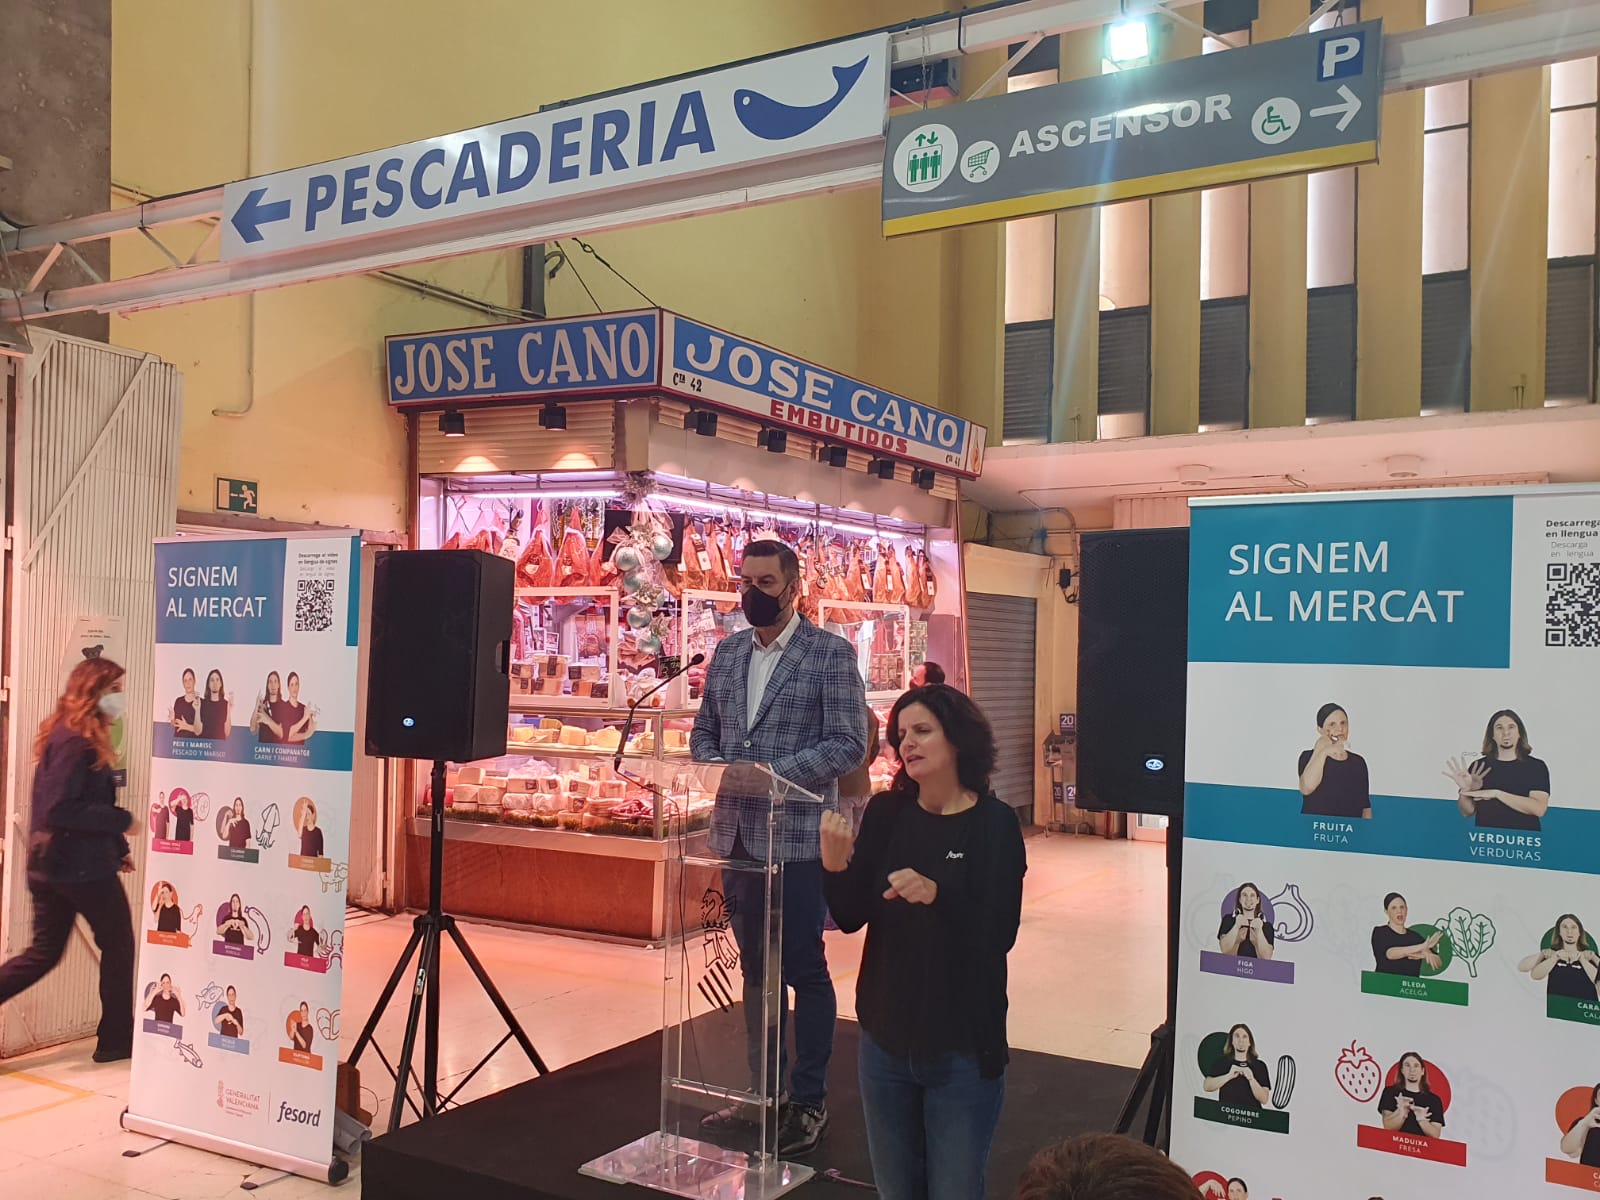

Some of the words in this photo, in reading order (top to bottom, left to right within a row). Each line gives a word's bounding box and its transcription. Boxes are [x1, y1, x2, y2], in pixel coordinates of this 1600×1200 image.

[1322, 37, 1362, 79] P
[1008, 93, 1233, 158] ASCENSOR
[304, 90, 716, 232] PESCADERIA
[394, 336, 497, 395] JOSE
[517, 322, 650, 385] CANO
[686, 335, 834, 410] JOSE
[850, 389, 958, 447] CANO
[690, 377, 702, 392] 42
[770, 399, 908, 454] EMBUTIDOS
[1560, 530, 1599, 539] llengua
[1228, 541, 1389, 575] SIGNEM
[167, 566, 238, 588] SIGNEM
[165, 597, 187, 617] AL
[193, 596, 267, 618] MERCAT
[1224, 591, 1273, 622] AL
[1288, 590, 1465, 623] MERCAT
[1061, 715, 1074, 725] 20
[1067, 786, 1075, 797] 2
[1313, 821, 1354, 832] FRUITA
[1313, 833, 1349, 844] FRUTA
[1469, 831, 1542, 847] VERDURES
[1469, 846, 1542, 862] VERDURAS
[1236, 967, 1254, 975] HIGO
[1237, 960, 1253, 968] FIGA
[1402, 980, 1427, 989] BLEDA
[1400, 987, 1429, 997] ACELGA
[225, 1088, 260, 1102] GENERALITAT
[277, 1101, 322, 1127] fesord
[1220, 1106, 1260, 1118] COGOMBRE
[1227, 1114, 1252, 1124] PEPINO
[1392, 1135, 1429, 1147] MADUIXA
[1399, 1144, 1421, 1153] FRESA
